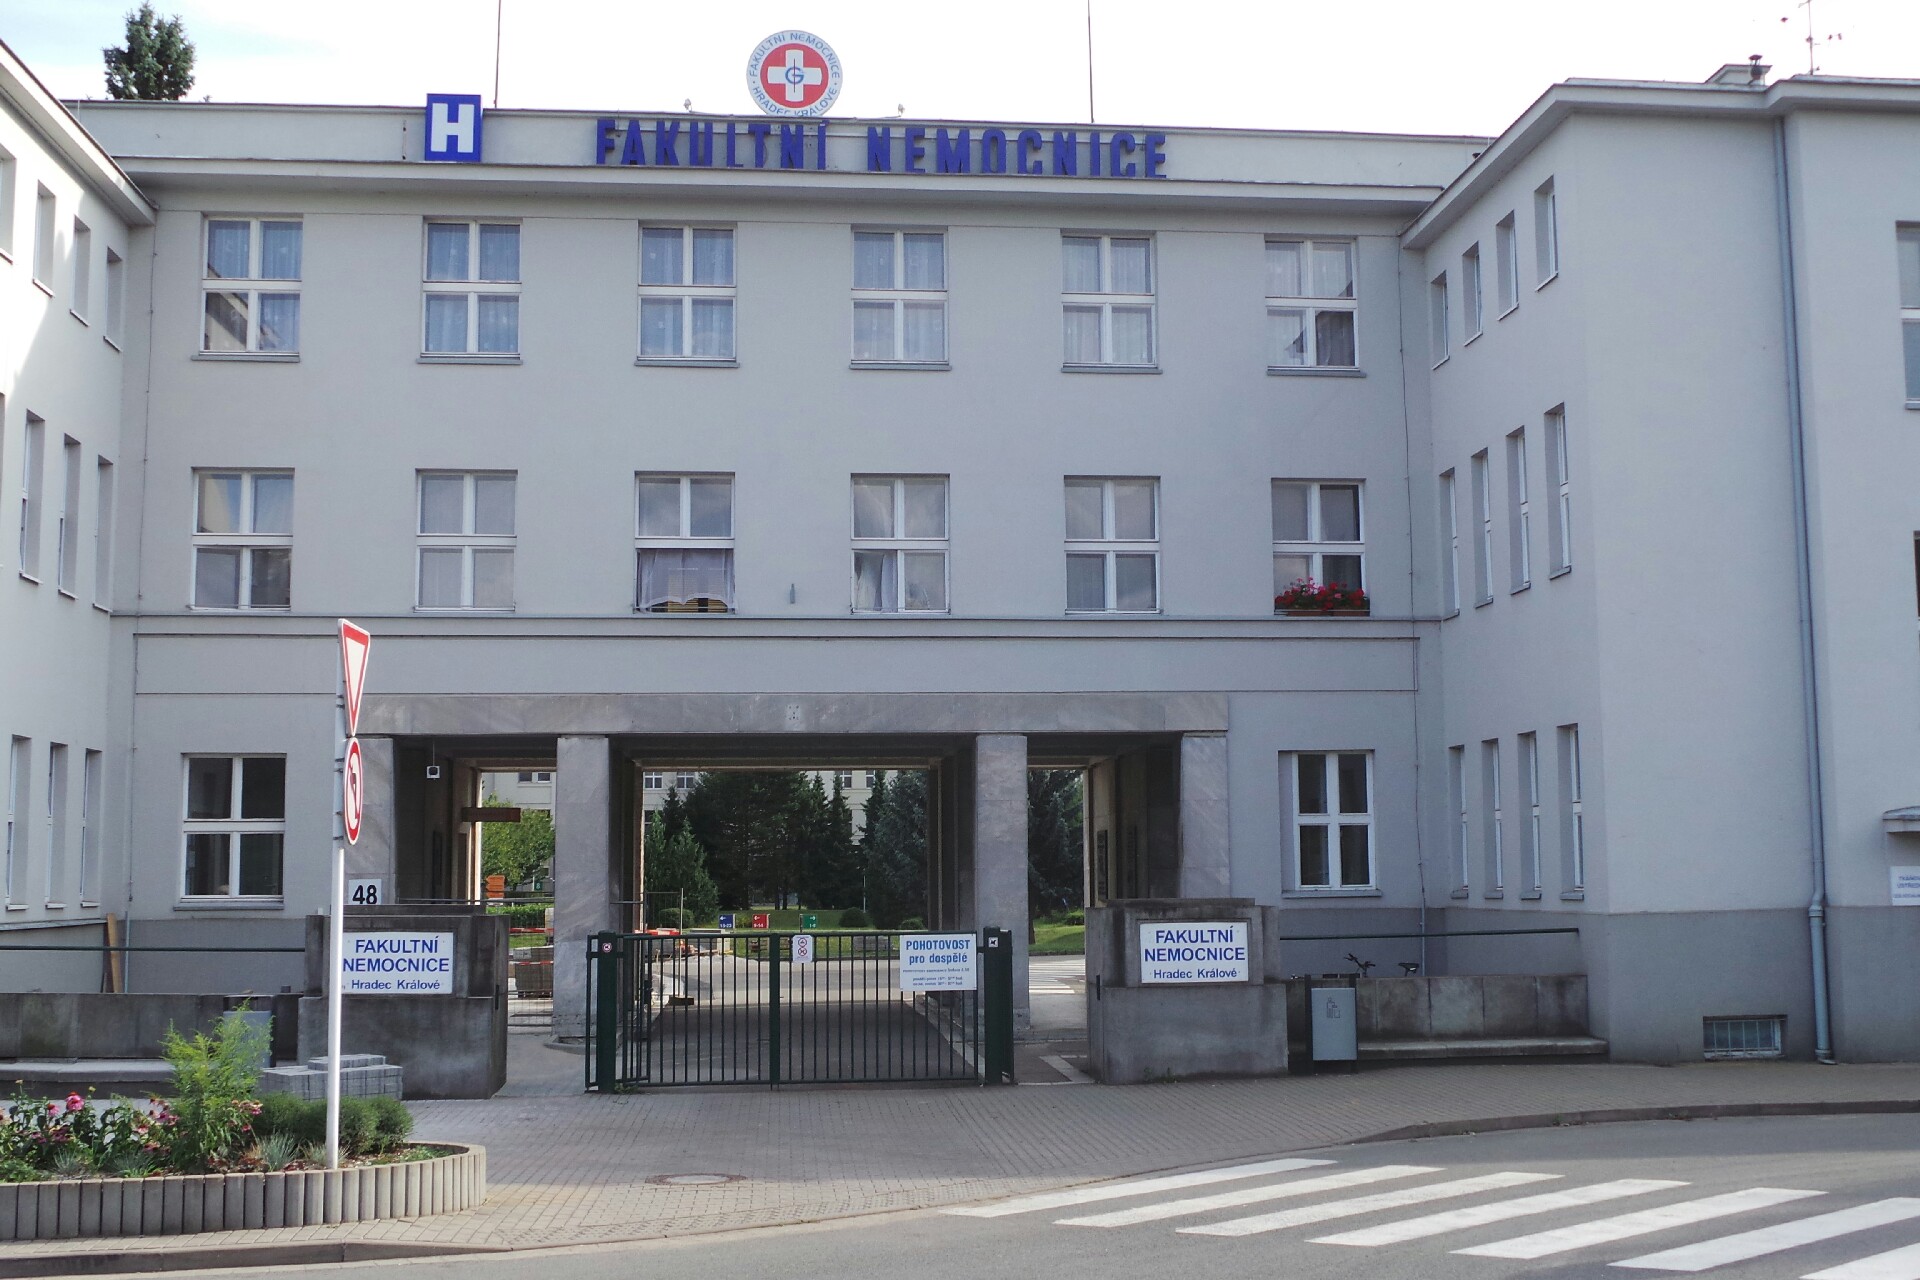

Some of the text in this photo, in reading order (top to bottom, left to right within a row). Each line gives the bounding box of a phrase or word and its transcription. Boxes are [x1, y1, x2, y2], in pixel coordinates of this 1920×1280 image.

[790, 32, 840, 78] NEMOCNICE
[431, 103, 475, 153] H
[596, 119, 1167, 179] FAKULTNÍ NEMOCNICE
[352, 884, 378, 905] 48
[1155, 925, 1234, 944] FAKULTNÍ
[355, 936, 439, 953] FAKULTNÍ
[906, 939, 971, 951] POHOTOVOST
[909, 952, 968, 965] pro dospělé
[1144, 947, 1246, 962] NEMOCNICE
[343, 958, 450, 972] NEMOCNICE
[1153, 968, 1237, 979] Hradec Králové
[351, 979, 440, 990] Hradec Králové
